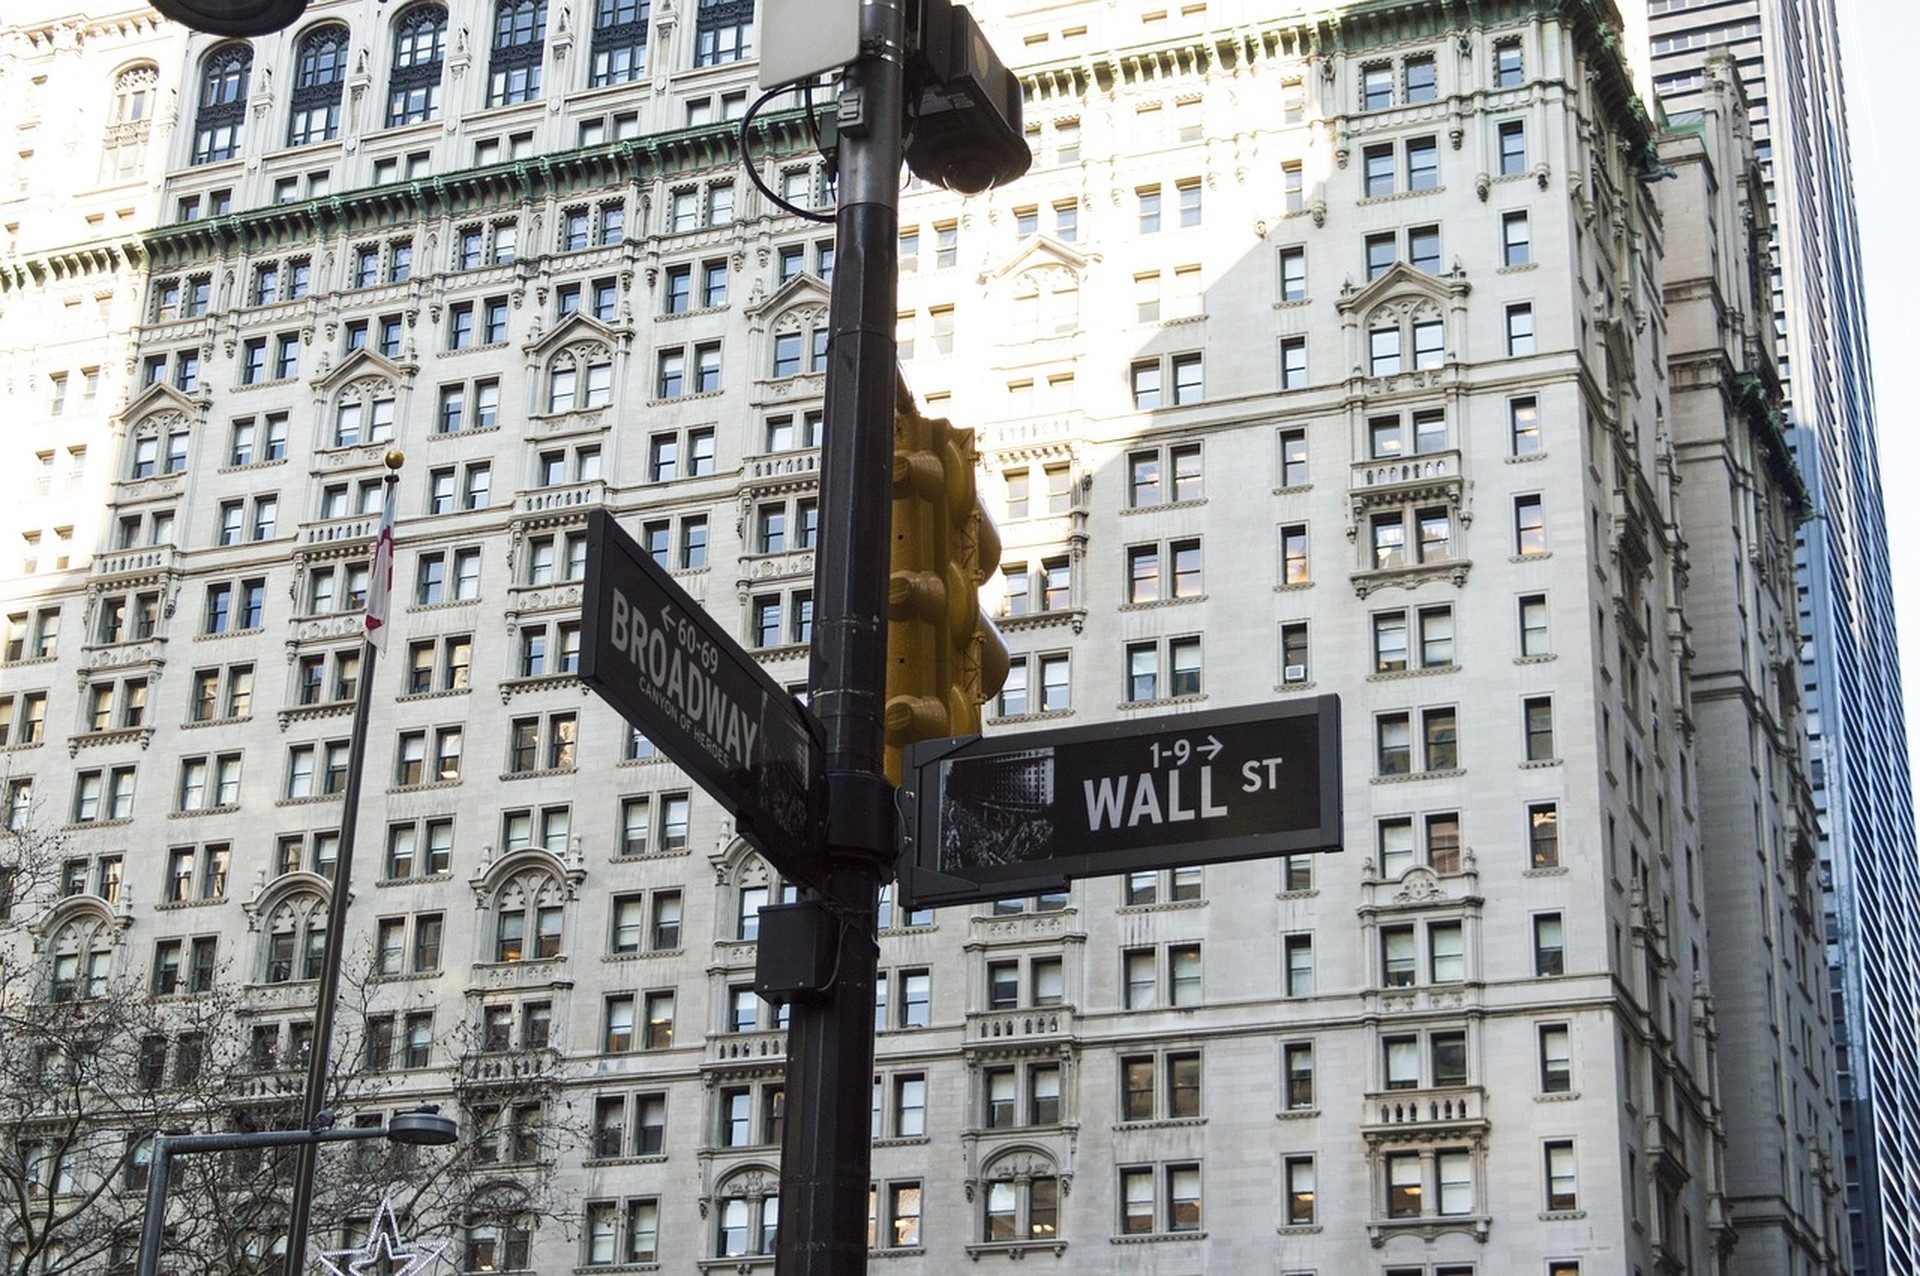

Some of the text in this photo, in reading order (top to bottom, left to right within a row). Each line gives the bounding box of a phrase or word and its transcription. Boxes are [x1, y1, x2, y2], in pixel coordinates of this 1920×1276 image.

[611, 587, 758, 771] BROADWAY
[677, 619, 719, 675] 60-69
[640, 676, 729, 769] CANYON OF HEROES
[1150, 739, 1191, 768] 1-9
[1083, 757, 1283, 831] WALL ST
